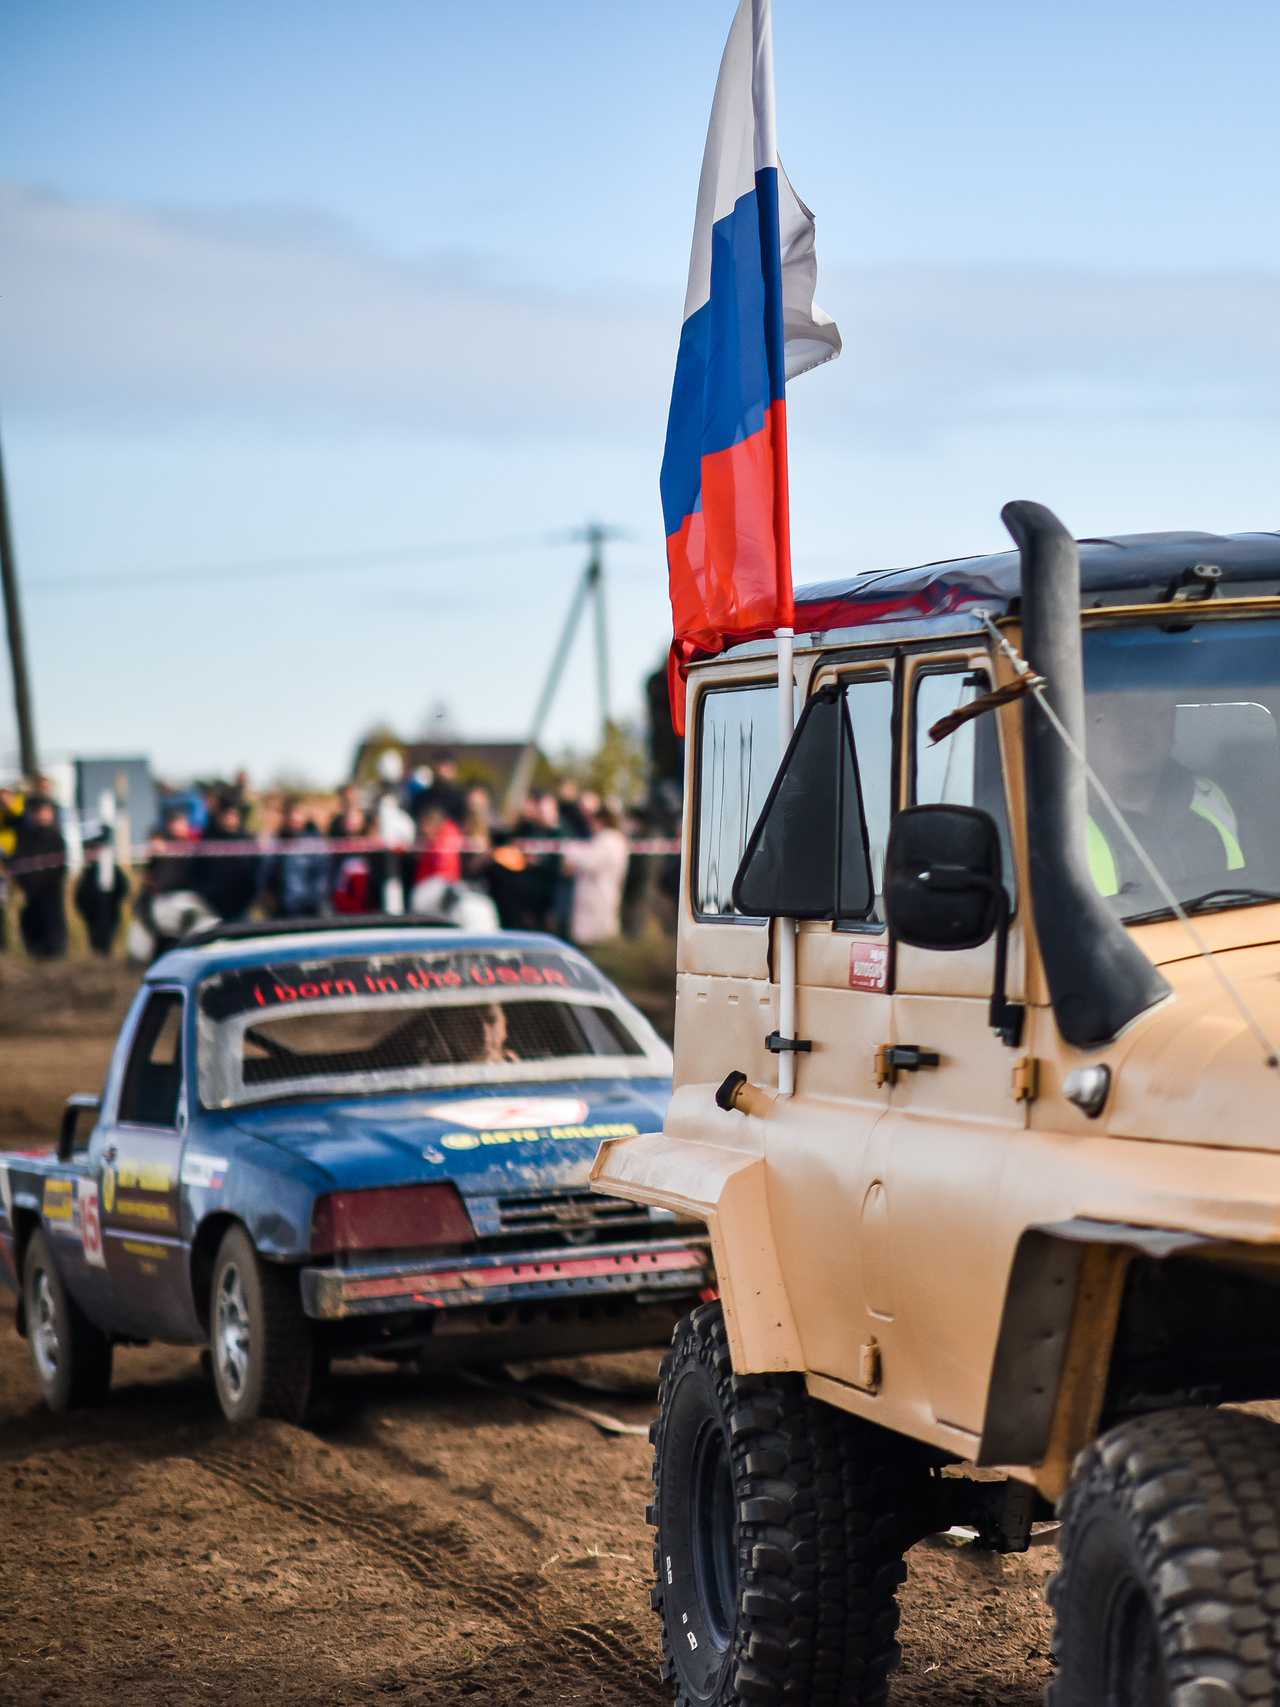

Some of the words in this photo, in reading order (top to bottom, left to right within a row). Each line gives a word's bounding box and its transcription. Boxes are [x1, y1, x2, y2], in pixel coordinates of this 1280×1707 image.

[274, 978, 357, 1003] born
[407, 968, 462, 990] the
[470, 965, 570, 988] USSR
